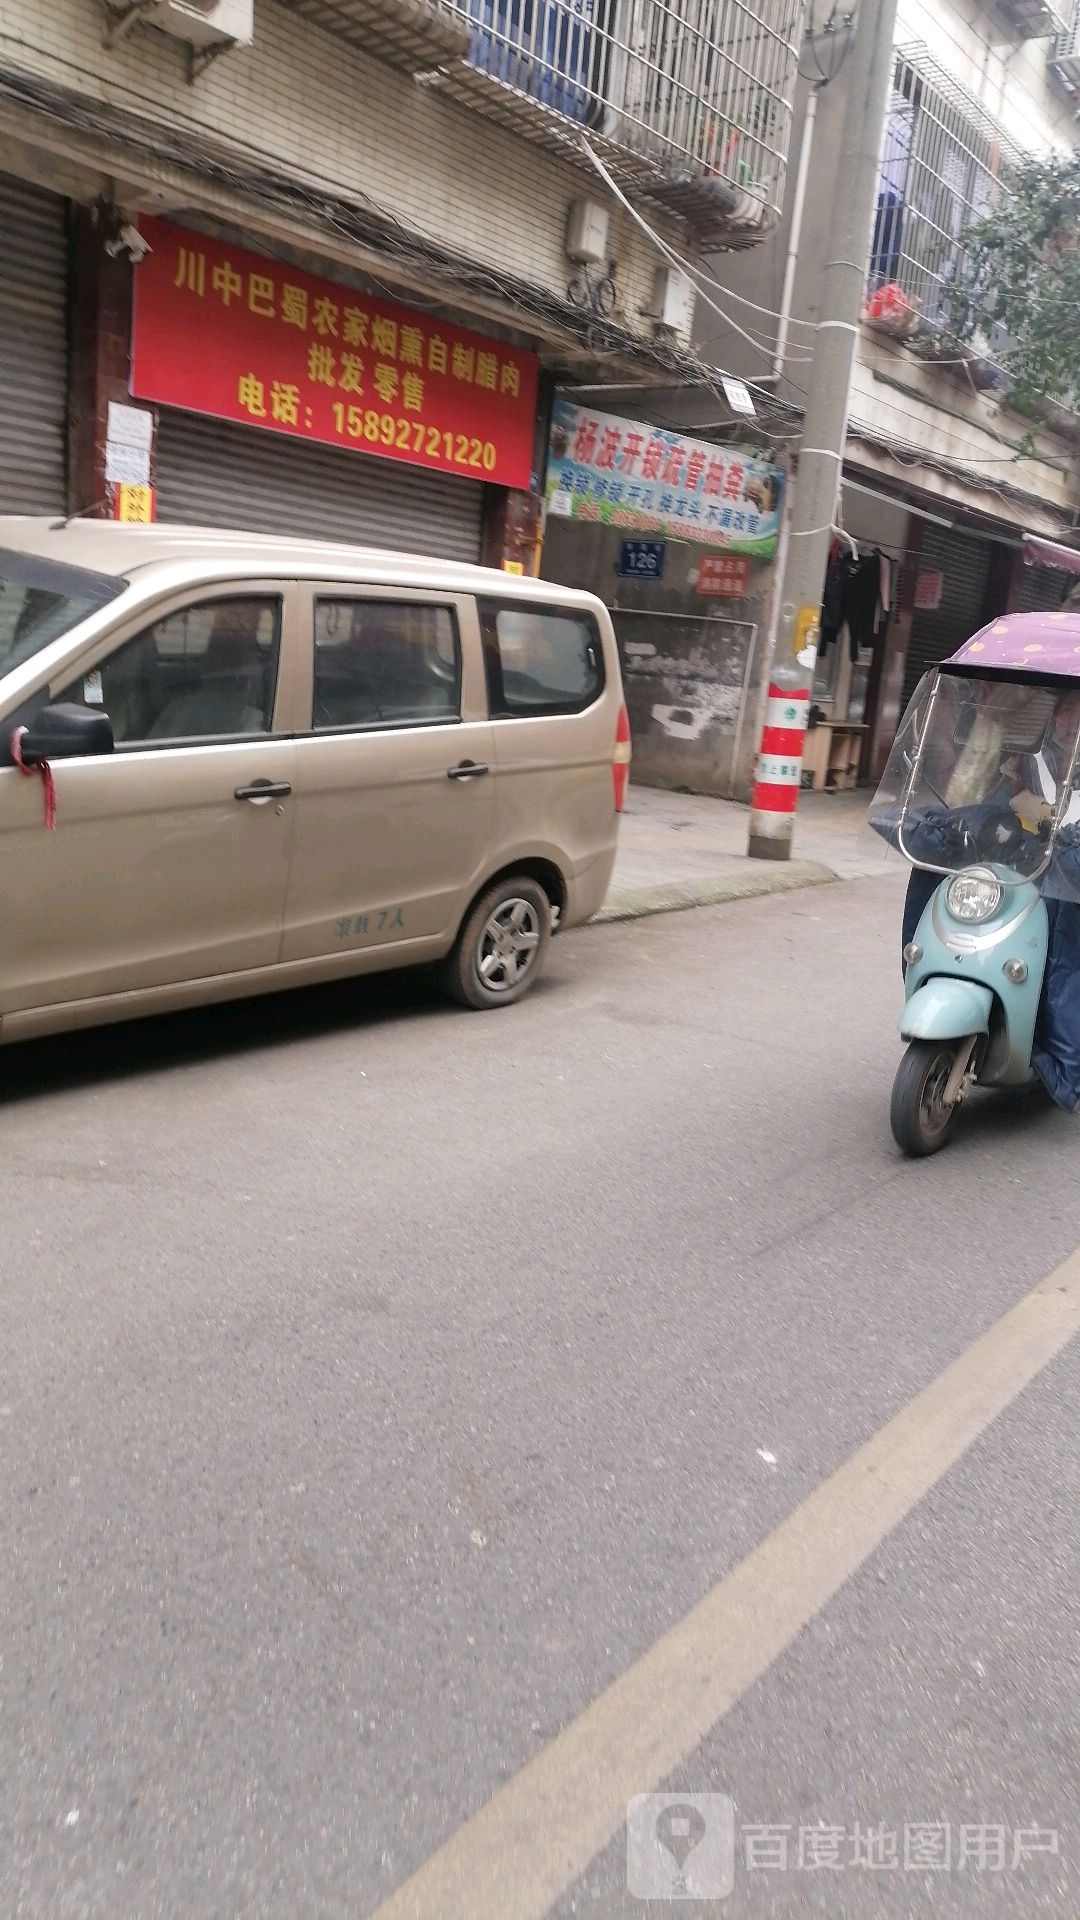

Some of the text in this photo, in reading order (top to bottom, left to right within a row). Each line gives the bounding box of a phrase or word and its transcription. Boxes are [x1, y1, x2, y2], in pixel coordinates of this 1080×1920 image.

[174, 246, 521, 398] 川中巴蜀农家烟熏自制腊肉
[628, 551, 658, 570] 126
